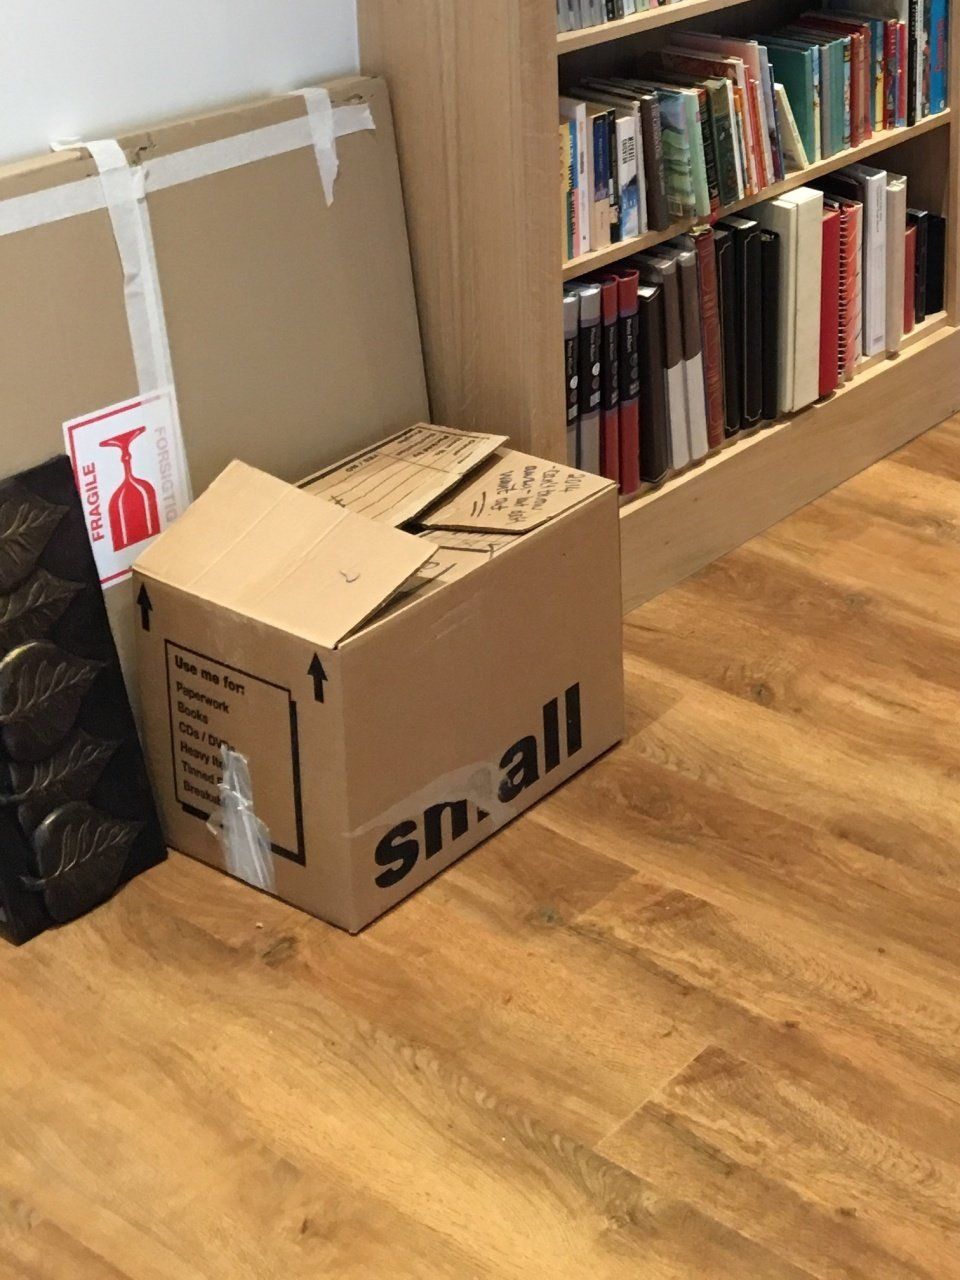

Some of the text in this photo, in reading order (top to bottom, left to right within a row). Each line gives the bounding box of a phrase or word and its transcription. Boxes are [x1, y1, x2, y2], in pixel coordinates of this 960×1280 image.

[83, 462, 105, 542] FRAGILE
[175, 654, 245, 695] Use me for:
[176, 681, 230, 714] Paperwork
[177, 701, 209, 725] Books
[179, 721, 200, 740] CDs
[180, 741, 210, 762] Heavy
[181, 760, 216, 785] Tinned
